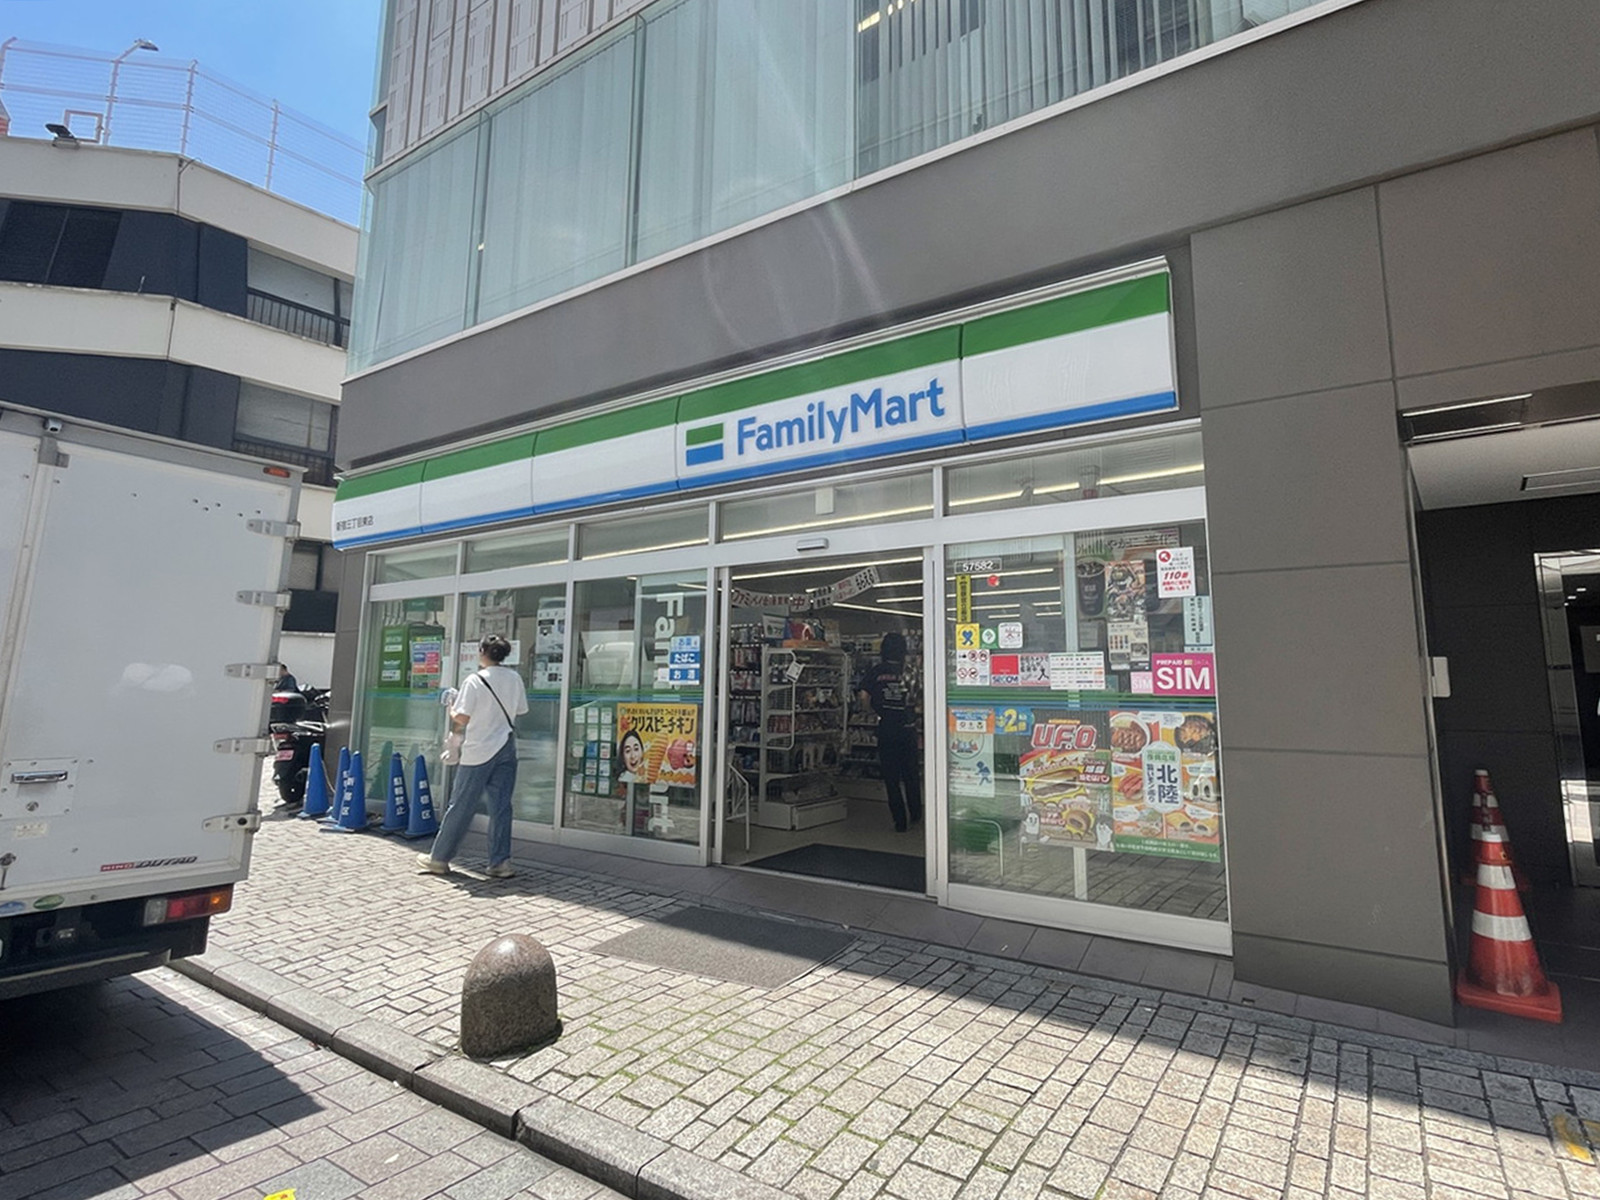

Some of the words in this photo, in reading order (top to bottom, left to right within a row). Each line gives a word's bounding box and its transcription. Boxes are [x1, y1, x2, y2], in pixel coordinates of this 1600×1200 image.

[738, 378, 945, 456] FamilyMart
[674, 653, 696, 663] たばこ
[993, 675, 1019, 684] SECOM
[1156, 667, 1210, 690] SIM
[631, 716, 694, 734] クリスピーチキン
[341, 777, 355, 816] 新宿区
[1157, 764, 1179, 804] 北陸
[419, 780, 431, 820] 新宿区
